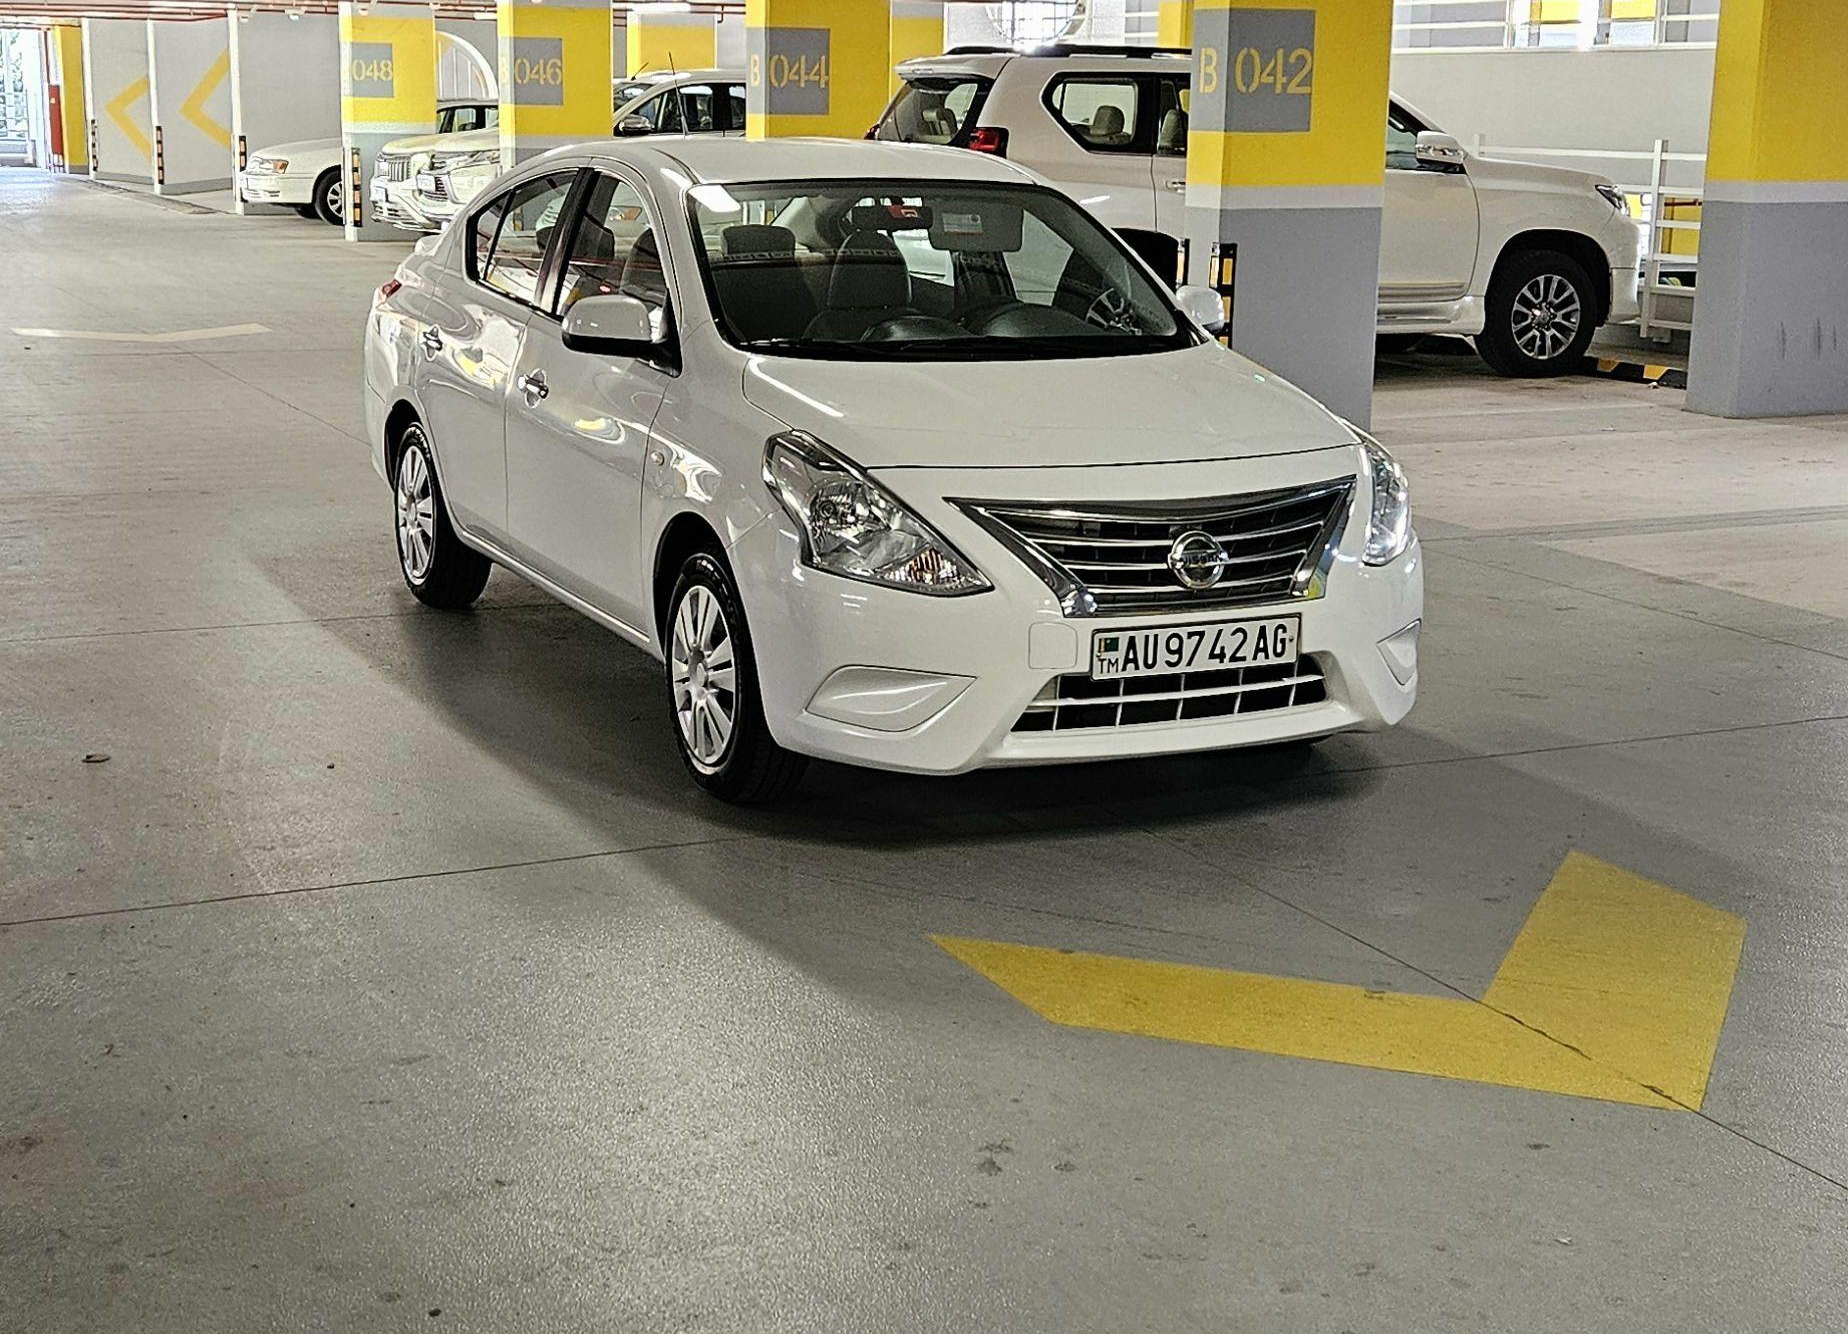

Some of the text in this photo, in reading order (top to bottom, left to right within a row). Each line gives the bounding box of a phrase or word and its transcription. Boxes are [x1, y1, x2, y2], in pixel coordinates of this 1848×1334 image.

[352, 59, 393, 82] 048
[514, 58, 562, 85] 046
[751, 54, 829, 88] B 044
[1199, 47, 1313, 95] B 042
[1098, 658, 1119, 675] TM
